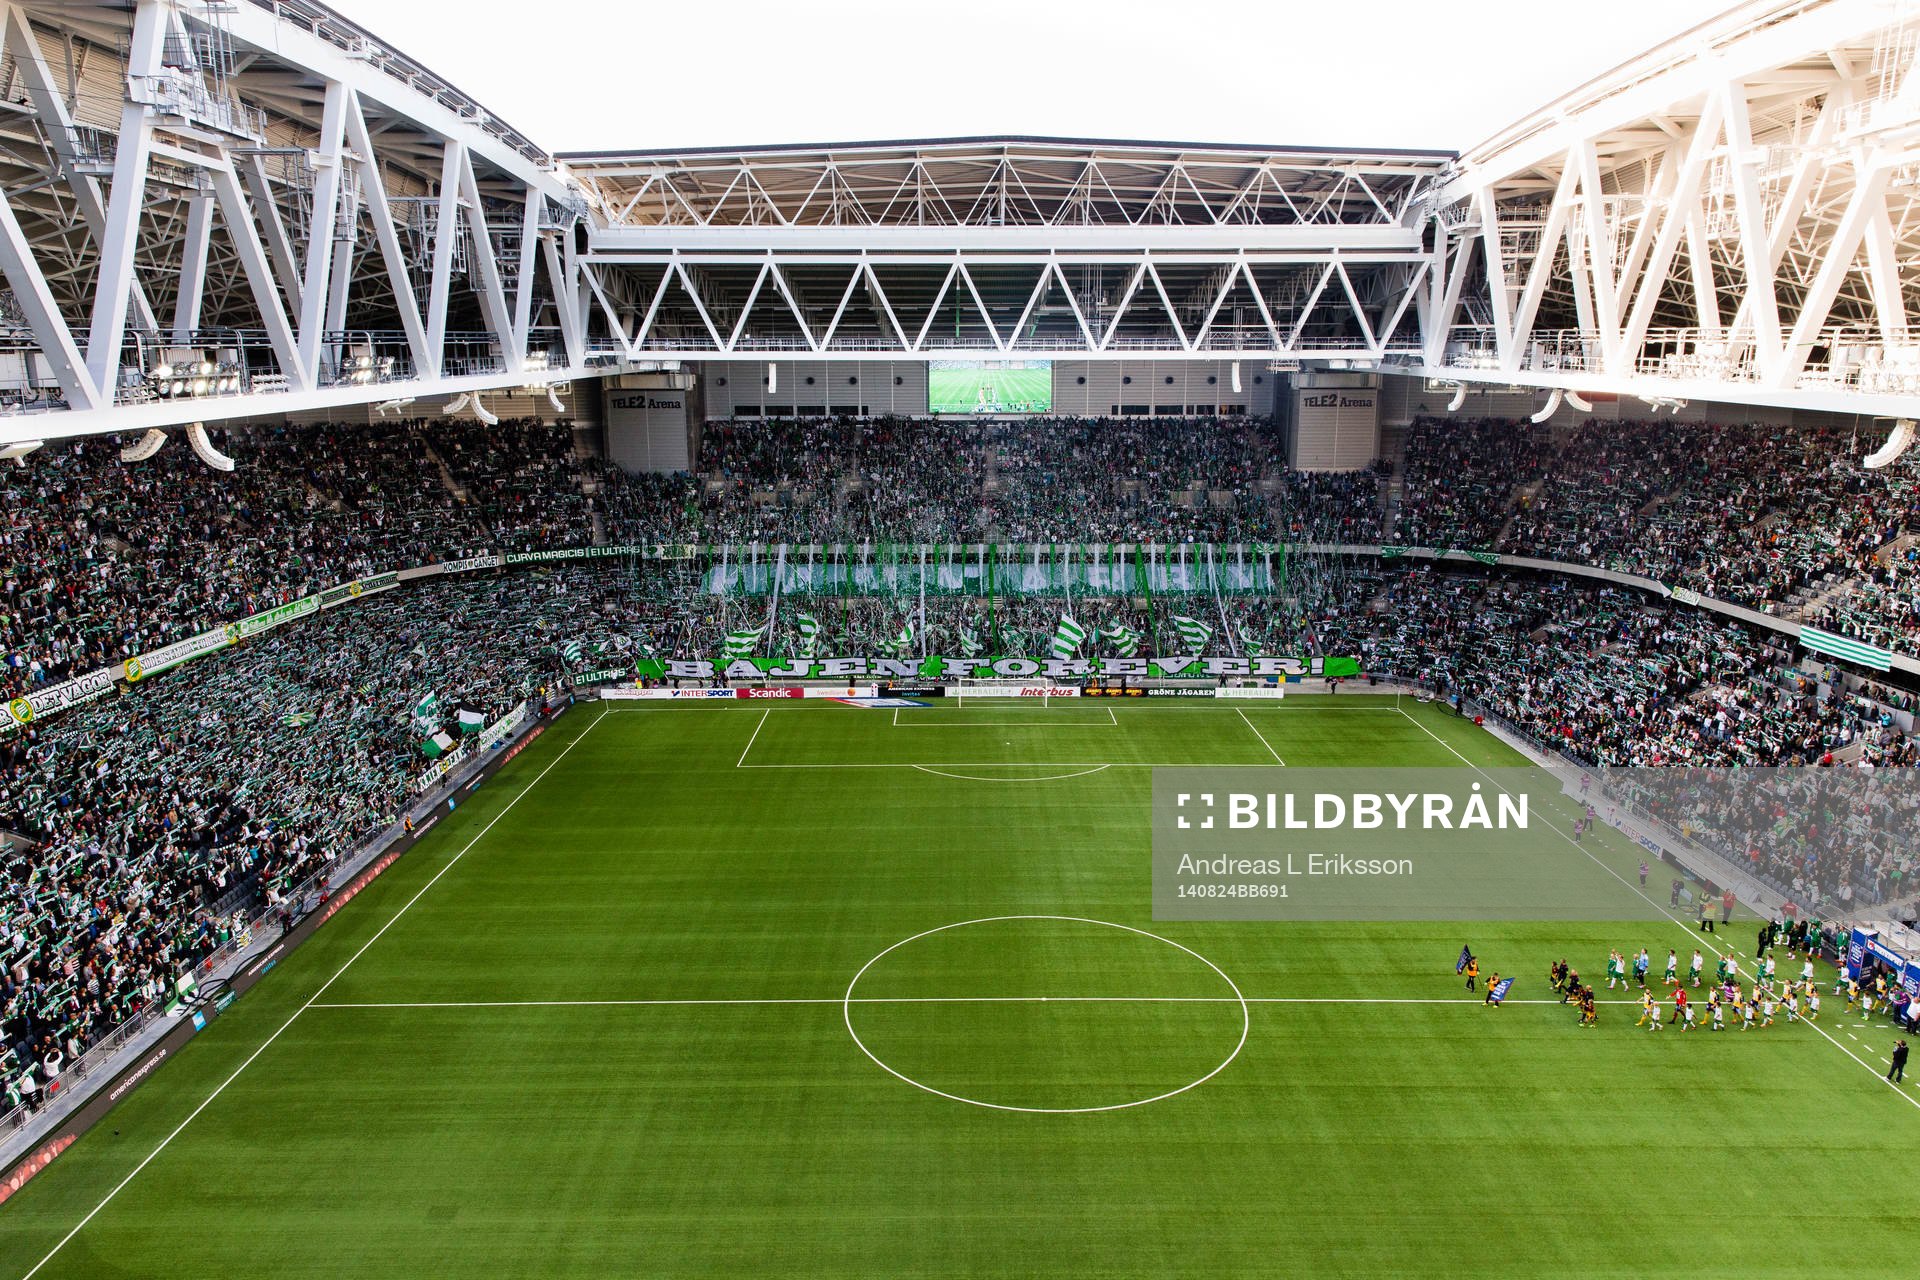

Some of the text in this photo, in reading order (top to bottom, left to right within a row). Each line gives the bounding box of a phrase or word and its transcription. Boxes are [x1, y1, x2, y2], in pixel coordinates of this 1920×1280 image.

[611, 395, 682, 409] TELE2 Arena
[1304, 394, 1373, 408] TELE2 Arena
[506, 551, 541, 564] CURVA
[542, 548, 585, 561] MAGICIS
[443, 559, 468, 573] KOMPIS
[664, 655, 1326, 678] BAJEN FOREVER!
[586, 668, 626, 682] ULTRS
[681, 689, 734, 697] INTERSPORT
[748, 687, 792, 698] Scandic
[1020, 687, 1074, 697] Interbus
[1148, 687, 1176, 696] GRÖNE
[1176, 687, 1215, 696] JÄGAREN
[30, 688, 61, 715] DET
[1620, 823, 1661, 856] INTERSPORT
[109, 1048, 167, 1101] americanexpress.se
